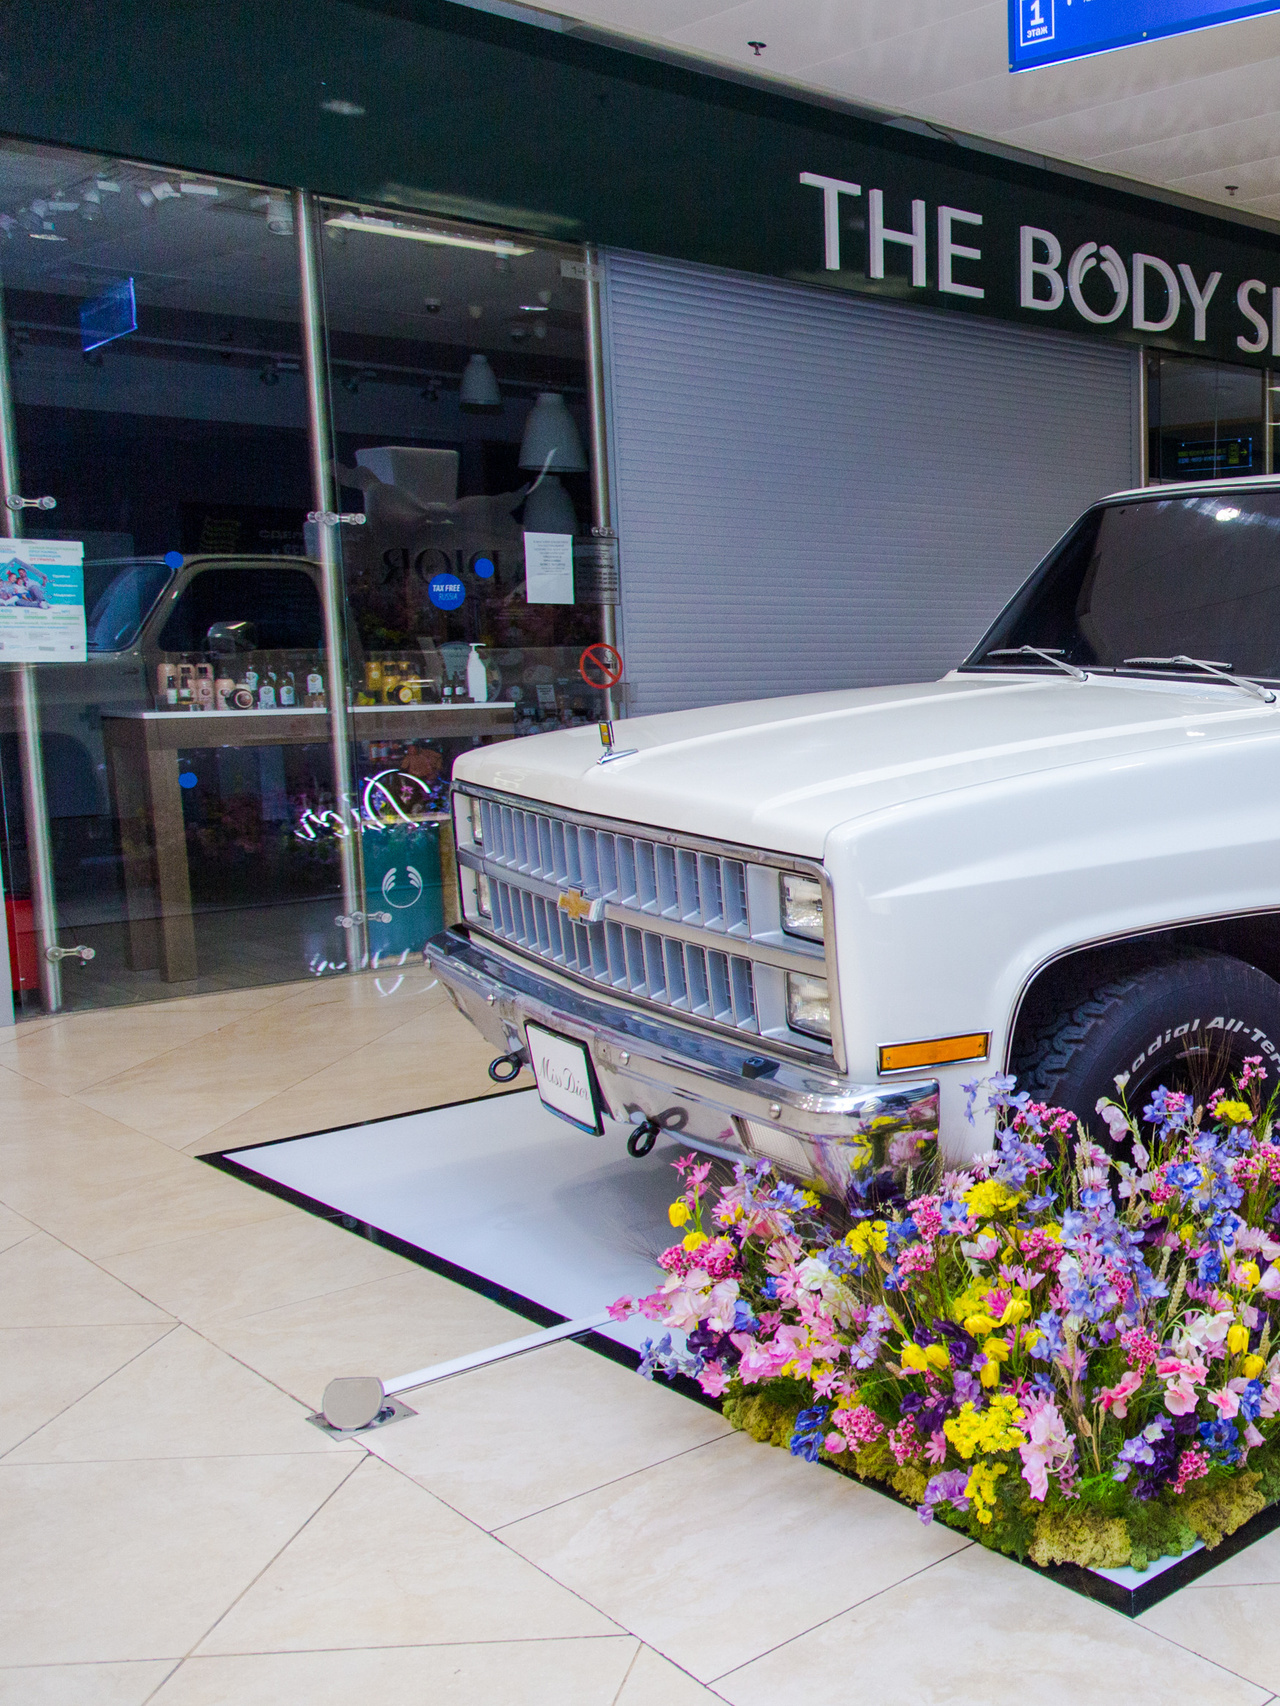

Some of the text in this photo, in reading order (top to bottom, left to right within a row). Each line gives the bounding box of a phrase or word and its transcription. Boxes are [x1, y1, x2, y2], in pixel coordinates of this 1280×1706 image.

[1030, 0, 1044, 26] 1
[1026, 26, 1048, 38] этаж
[800, 171, 984, 299] THE
[1020, 225, 1222, 342] BODY
[432, 584, 460, 592] TAX FREE
[438, 592, 457, 601] RUSSIA
[1130, 1018, 1200, 1073] adial
[538, 1057, 590, 1100] Miss Dior
